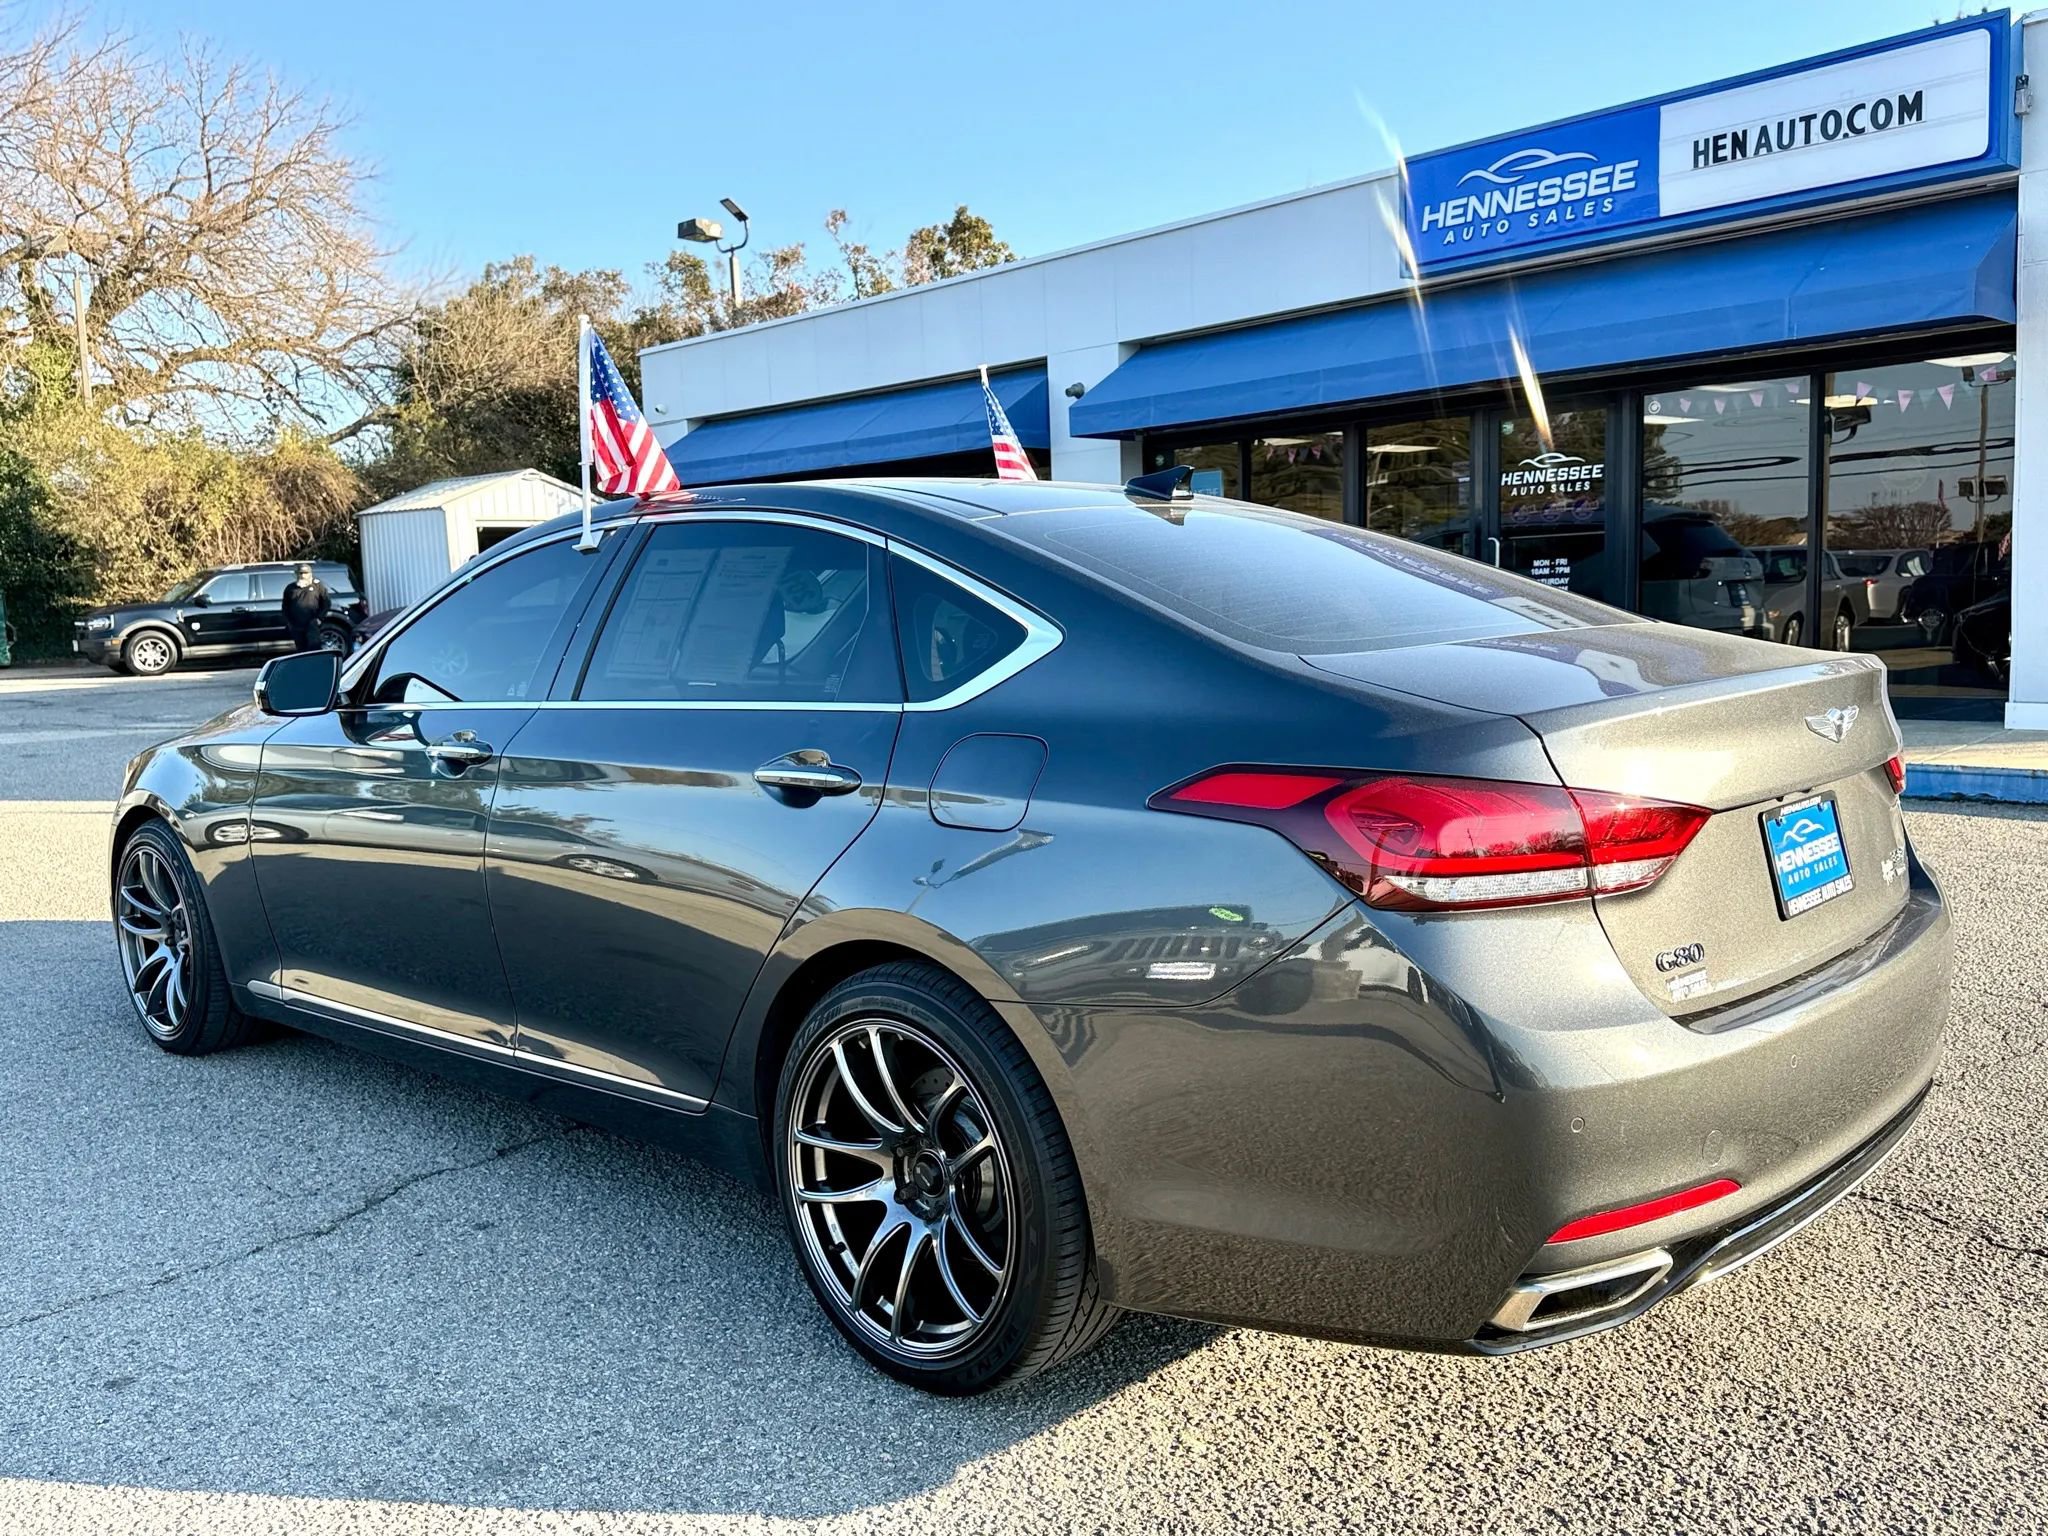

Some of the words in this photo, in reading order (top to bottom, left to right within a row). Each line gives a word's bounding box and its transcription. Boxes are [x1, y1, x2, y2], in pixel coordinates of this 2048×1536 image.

[1693, 90, 1923, 169] HENAUTO.COM
[1422, 160, 1639, 232] HENNESSEE
[1443, 220, 1509, 244] AUTO
[1528, 198, 1613, 228] SALES
[1501, 464, 1604, 486] HENNESSEE
[1511, 485, 1545, 496] AUTO
[1550, 481, 1591, 493] SALES
[1555, 566, 1571, 574] 7PM
[1774, 832, 1840, 874] HENNESSEE
[1788, 868, 1811, 885] AUTO
[1814, 856, 1838, 874] SALES
[1655, 943, 1704, 972] G80
